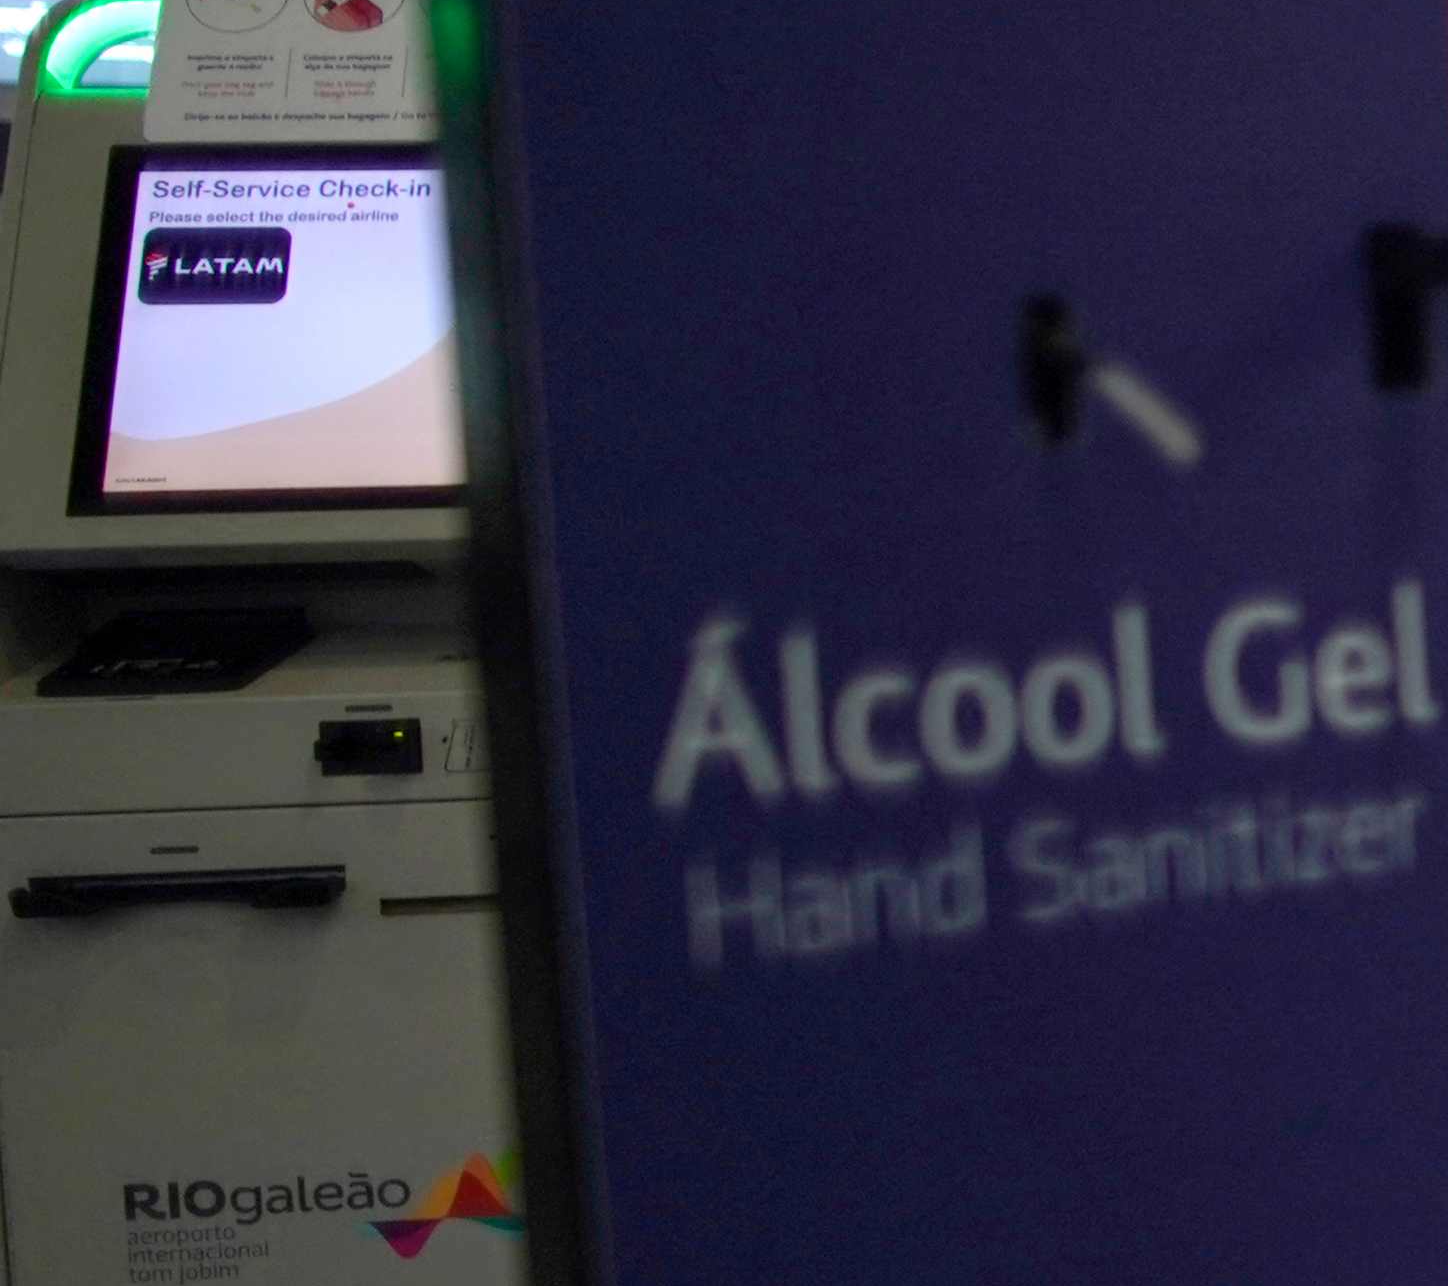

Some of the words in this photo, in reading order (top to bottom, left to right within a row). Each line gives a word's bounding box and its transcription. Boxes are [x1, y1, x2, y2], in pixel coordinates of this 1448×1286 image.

[152, 179, 311, 199] Self-Service
[319, 178, 432, 198] Check-in
[149, 211, 202, 223] Please
[206, 211, 255, 223] select
[259, 210, 284, 222] the
[287, 210, 347, 222] desired
[350, 211, 400, 222] airline
[174, 257, 285, 274] LATAM
[650, 605, 1168, 813] Álcool
[1202, 579, 1438, 745] Gel
[683, 821, 989, 975] Hand
[1010, 788, 1424, 925] Sanitizer
[127, 1224, 237, 1247] aeroporto
[127, 1239, 271, 1264] internacional
[129, 1265, 174, 1284] tom
[176, 1262, 241, 1286] jobim
